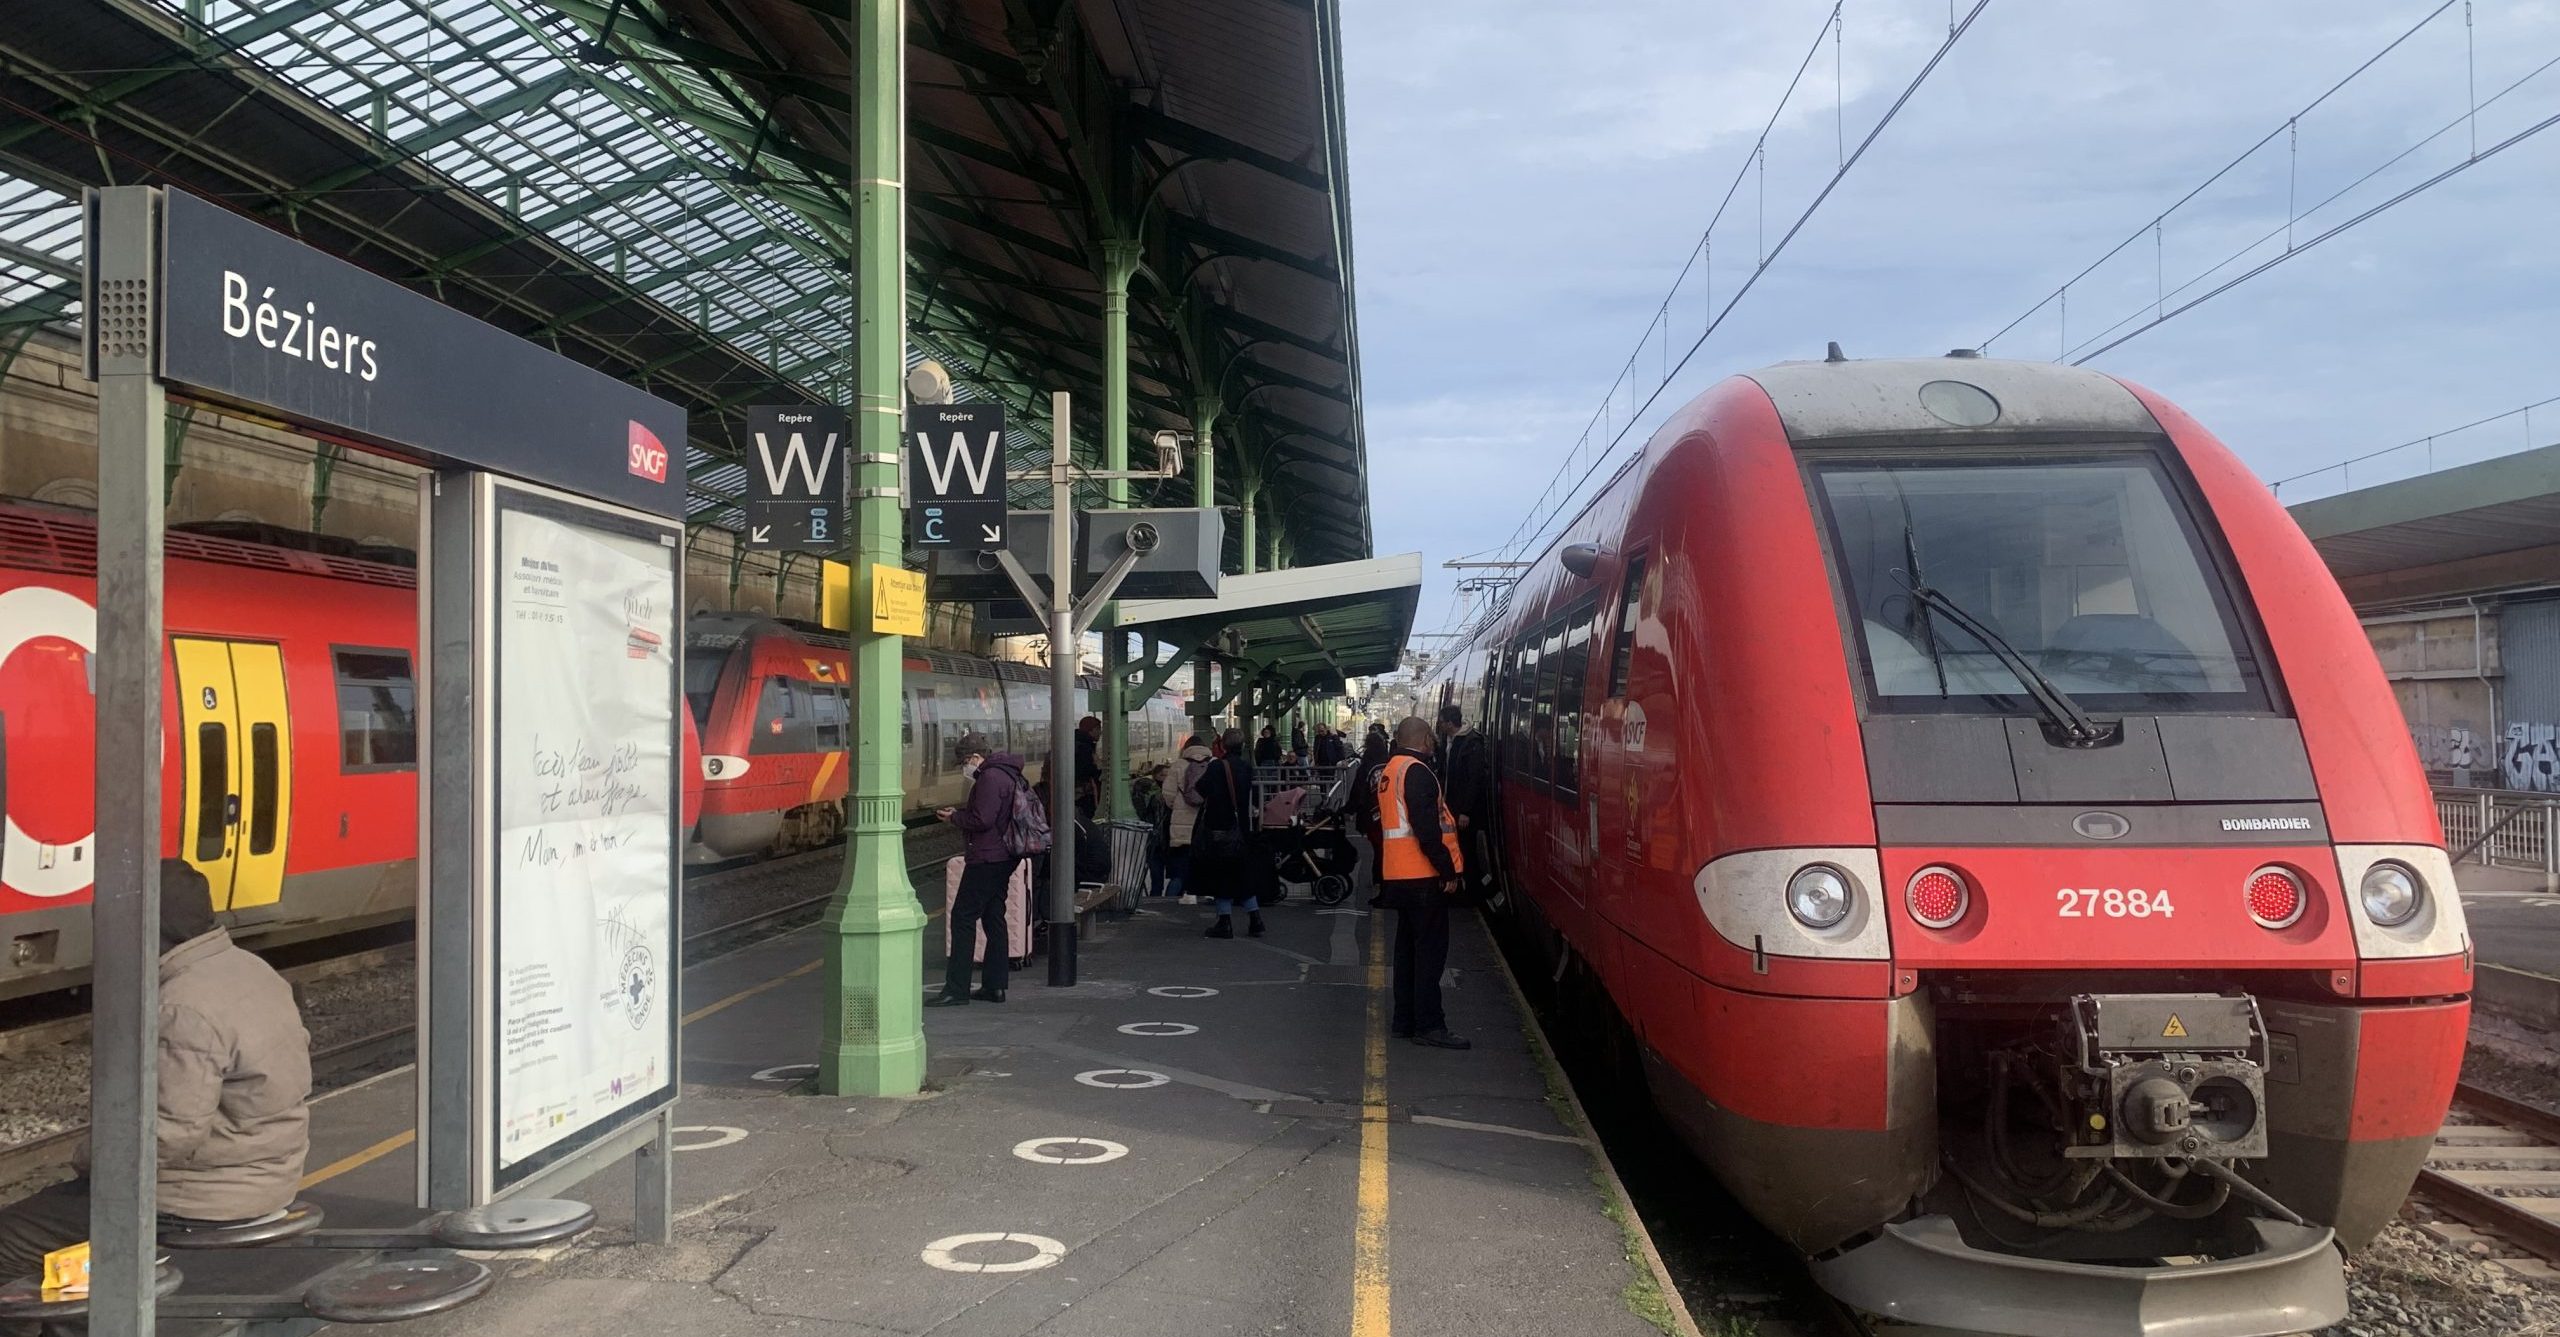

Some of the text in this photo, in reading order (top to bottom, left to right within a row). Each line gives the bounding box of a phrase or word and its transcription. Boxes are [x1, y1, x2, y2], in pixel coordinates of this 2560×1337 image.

[224, 270, 378, 382] Béziers
[778, 413, 813, 425] Repère
[939, 412, 974, 424] Repère
[630, 443, 666, 475] SNCF
[754, 432, 838, 496] W
[916, 431, 1000, 496] W
[811, 518, 827, 540] B
[925, 518, 944, 540] C
[2221, 818, 2311, 831] BOMBARDIER
[2056, 888, 2175, 918] 27884
